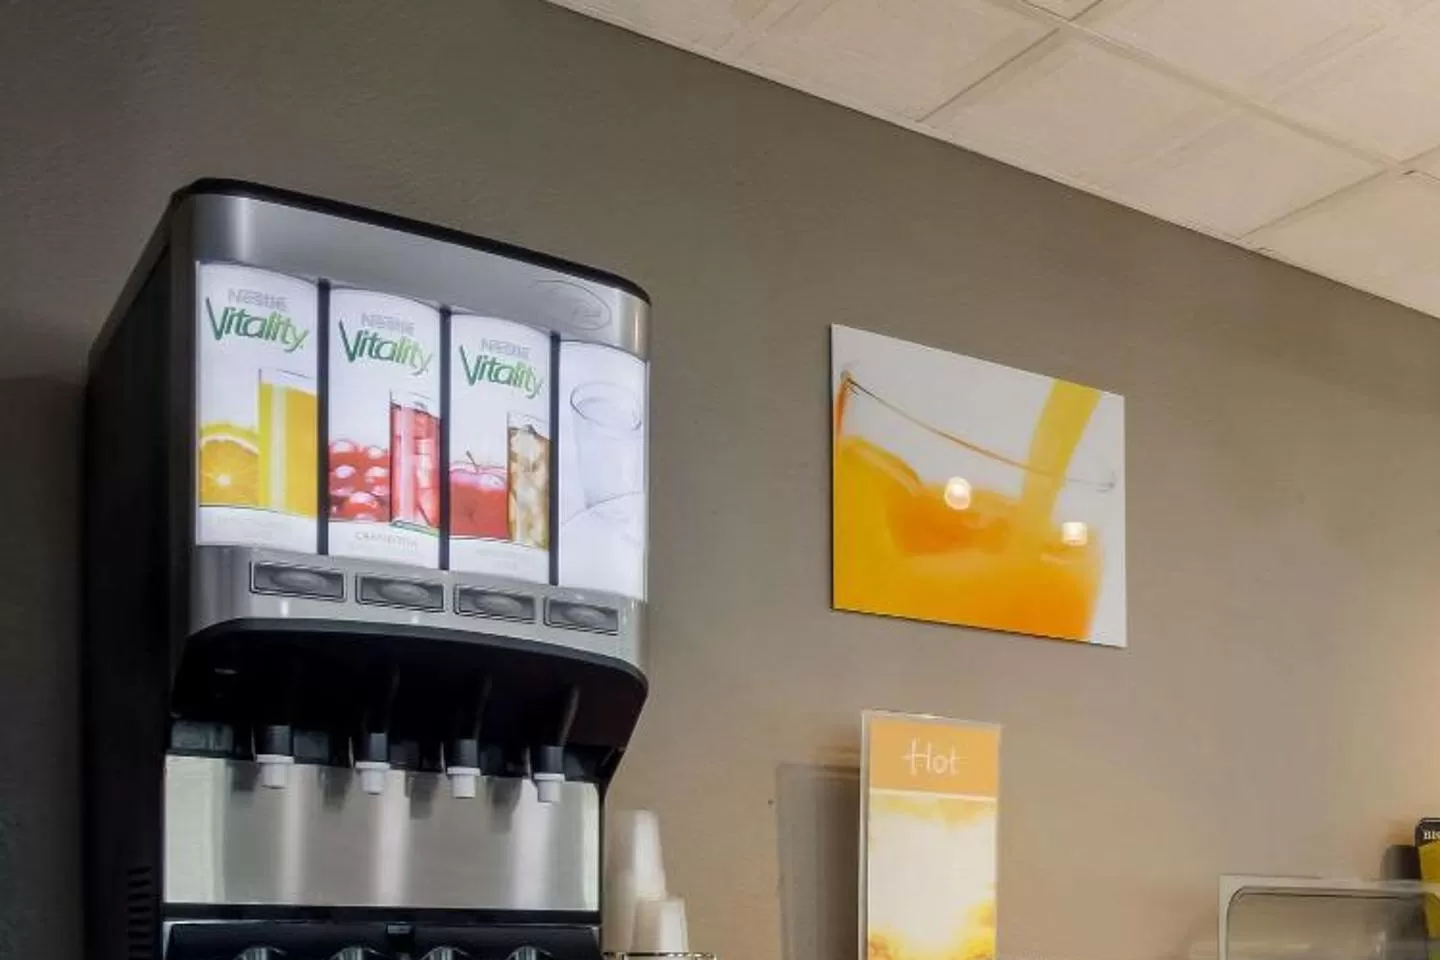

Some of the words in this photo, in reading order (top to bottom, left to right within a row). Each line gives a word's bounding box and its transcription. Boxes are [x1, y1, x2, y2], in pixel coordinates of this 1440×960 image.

[205, 297, 309, 353] Vitality
[338, 319, 433, 376] Vitality
[459, 344, 543, 399] Vitality
[901, 737, 968, 776] Hot
